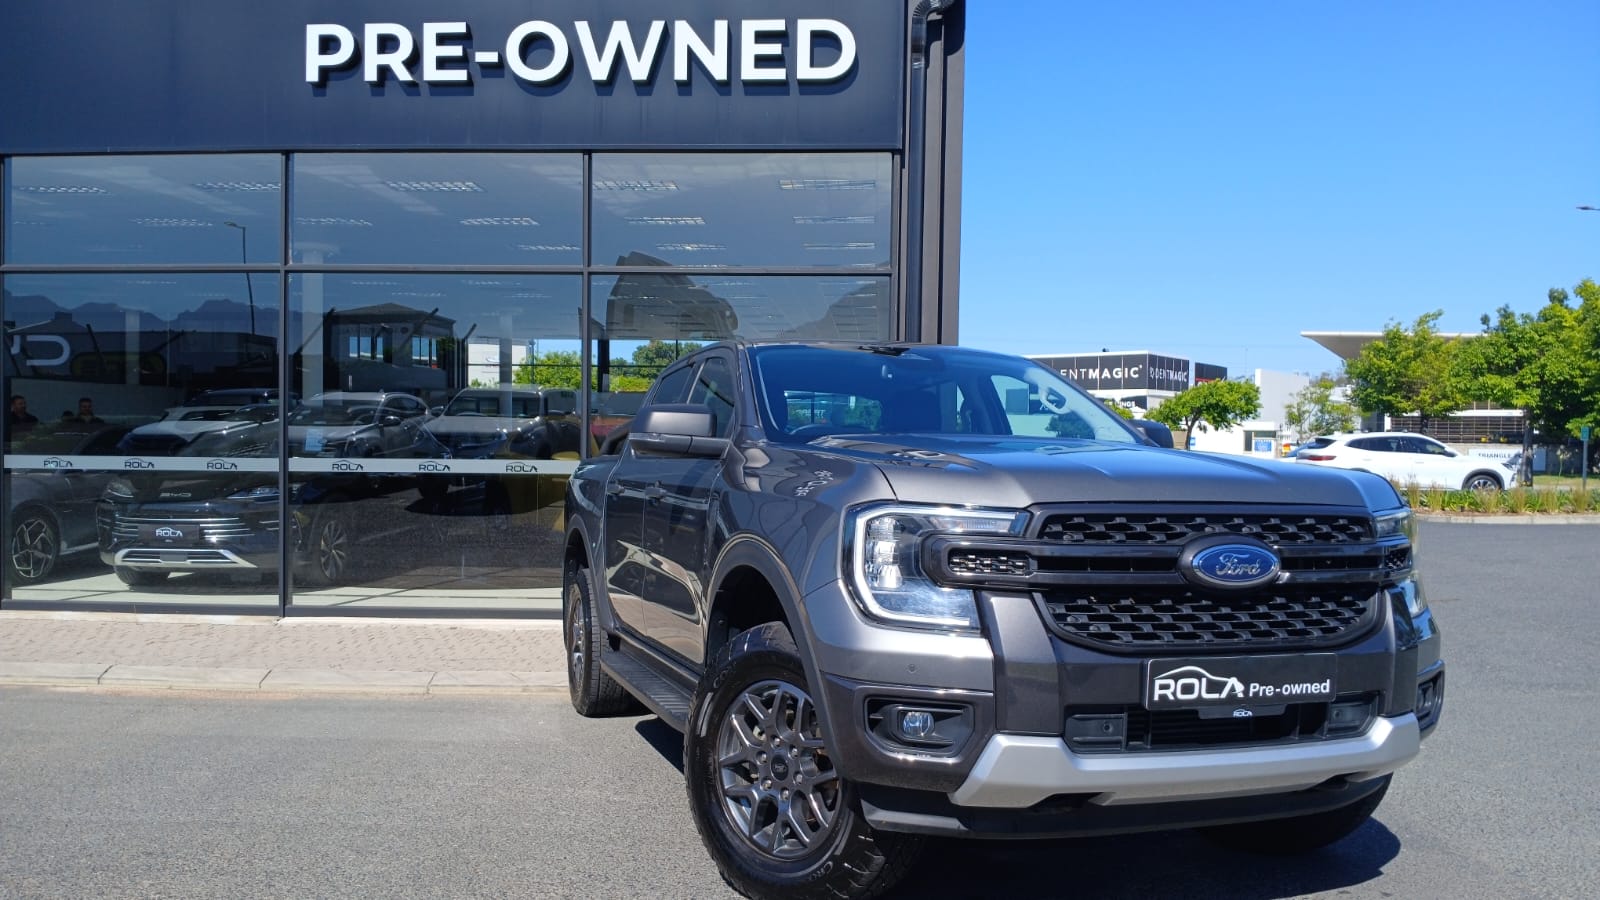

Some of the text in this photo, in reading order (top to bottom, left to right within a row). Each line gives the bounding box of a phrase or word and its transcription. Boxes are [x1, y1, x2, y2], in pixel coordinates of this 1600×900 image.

[305, 18, 856, 83] PRE-OWNED
[124, 460, 155, 469] ROLA
[207, 461, 238, 470] ROLA
[332, 462, 364, 471] ROLA
[418, 463, 450, 472] ROLA
[505, 464, 538, 473] ROLA
[156, 529, 183, 537] ROLA
[1215, 552, 1261, 576] Ford
[1154, 674, 1330, 701] ROLA Pre-owned
